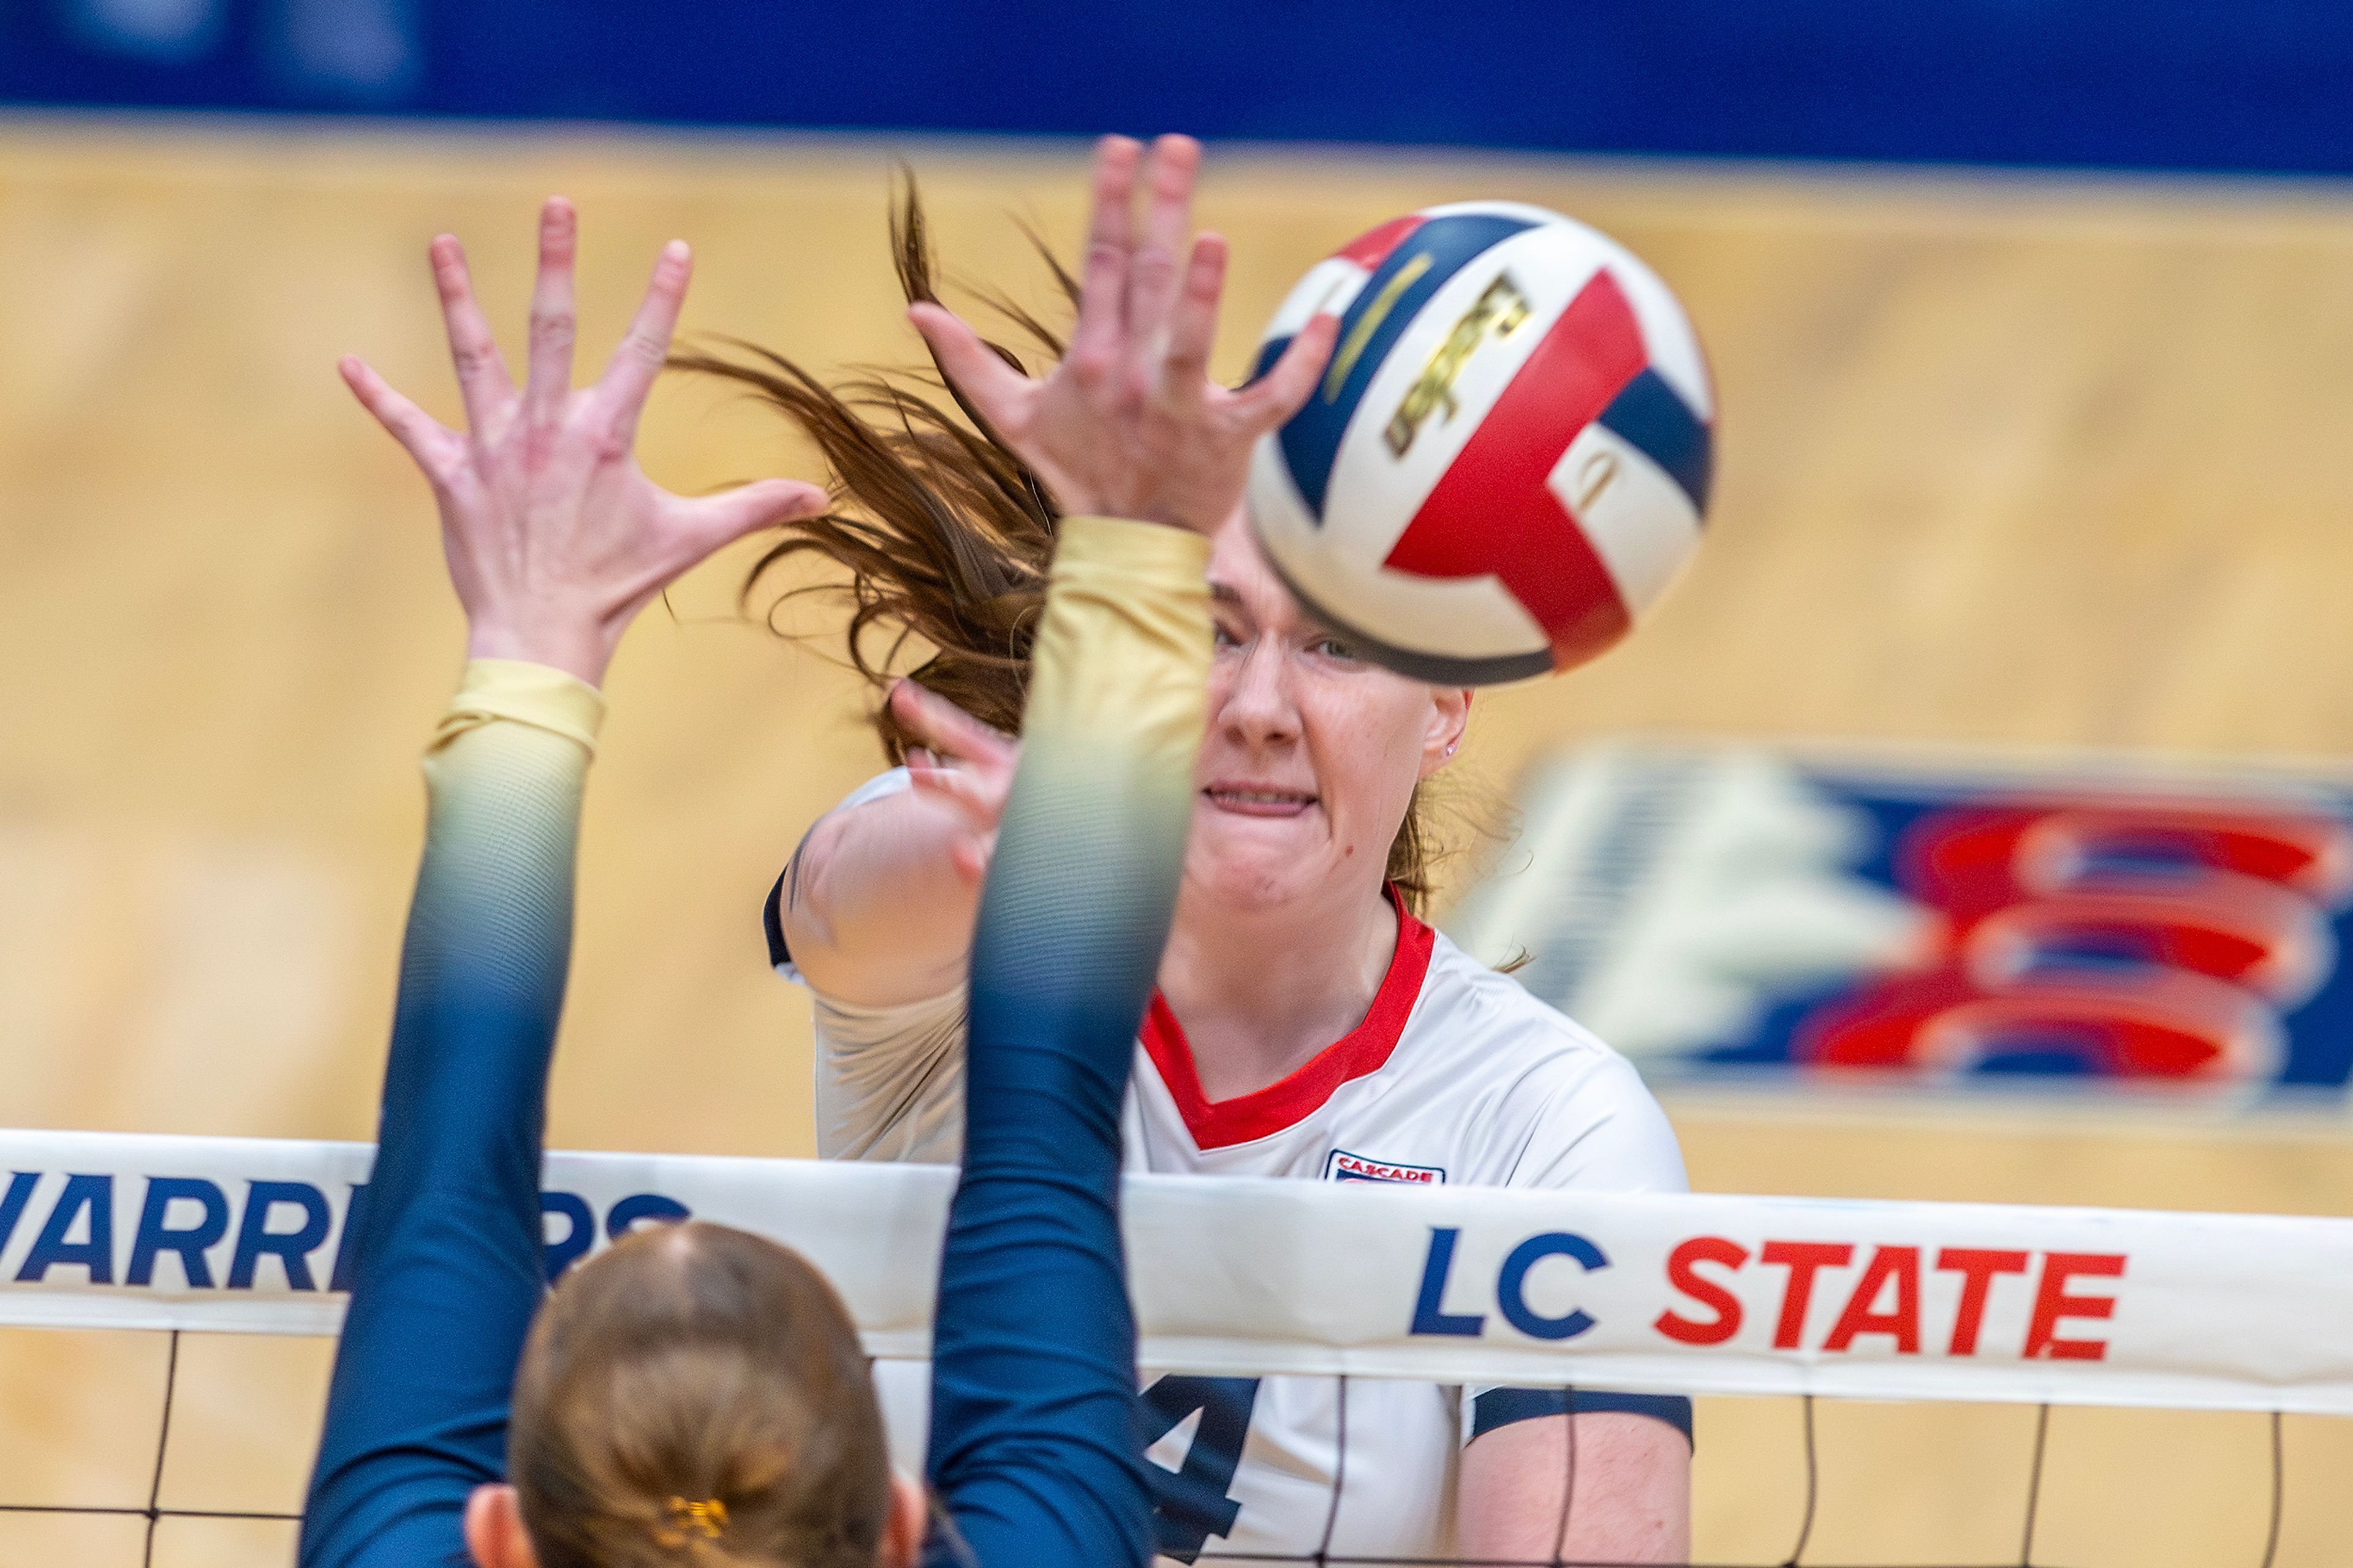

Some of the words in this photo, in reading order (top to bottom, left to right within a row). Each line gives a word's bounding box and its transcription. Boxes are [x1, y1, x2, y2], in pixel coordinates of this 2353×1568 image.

[1338, 1157, 1433, 1183] CASCADE
[1408, 1225, 1613, 1341] LC
[1653, 1235, 2129, 1362] STATE
